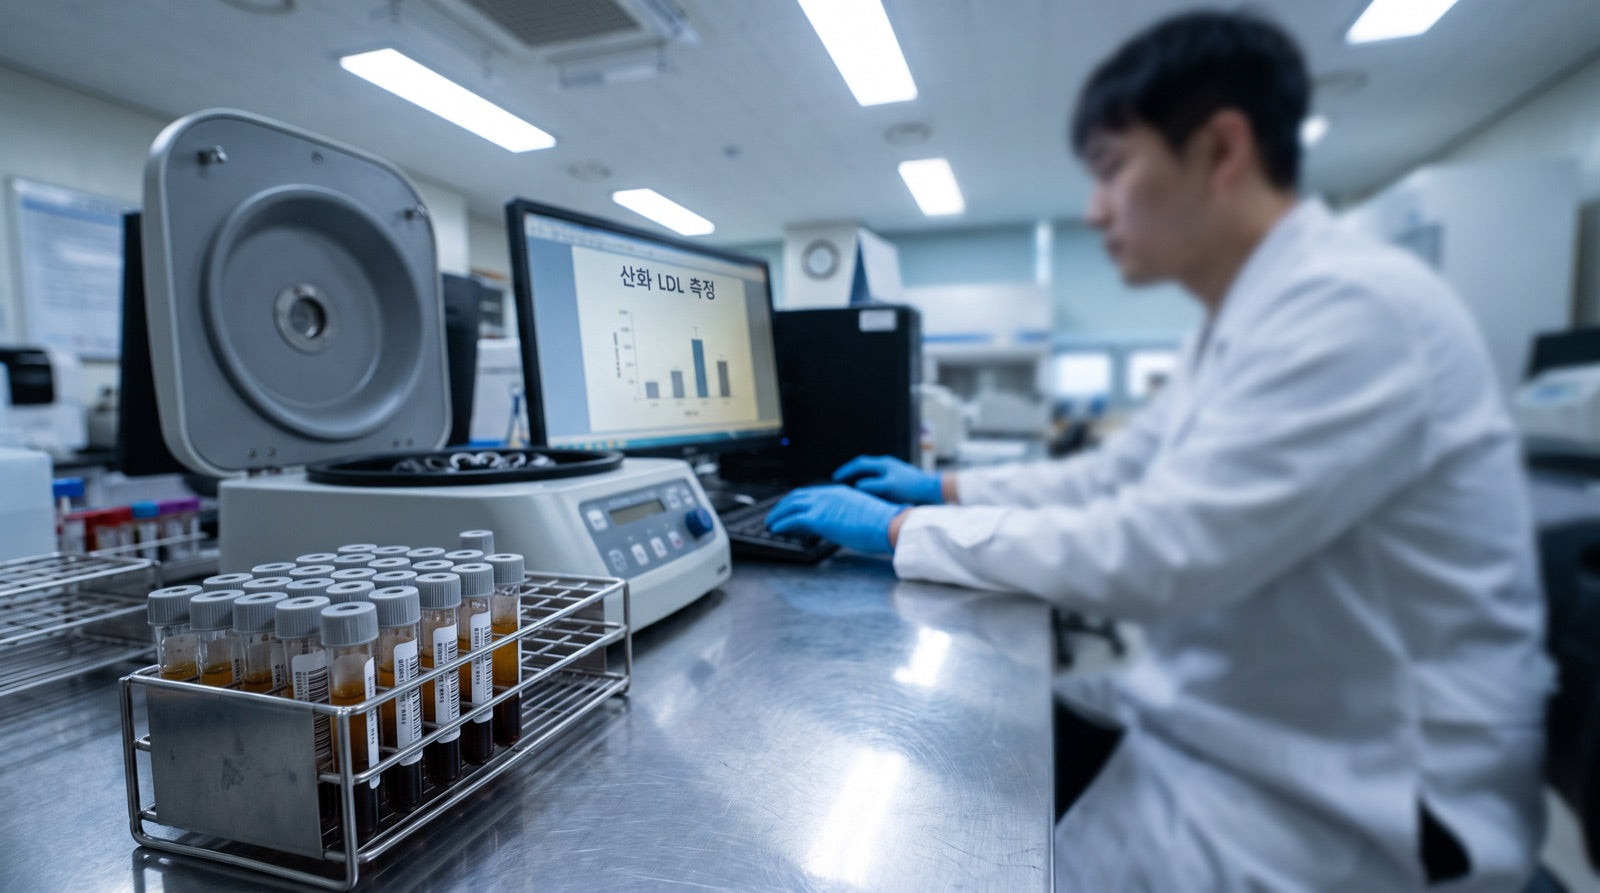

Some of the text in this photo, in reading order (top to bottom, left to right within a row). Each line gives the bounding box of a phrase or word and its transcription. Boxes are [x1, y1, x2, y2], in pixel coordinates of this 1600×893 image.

[620, 265, 716, 301] 산화 LDL 측정
